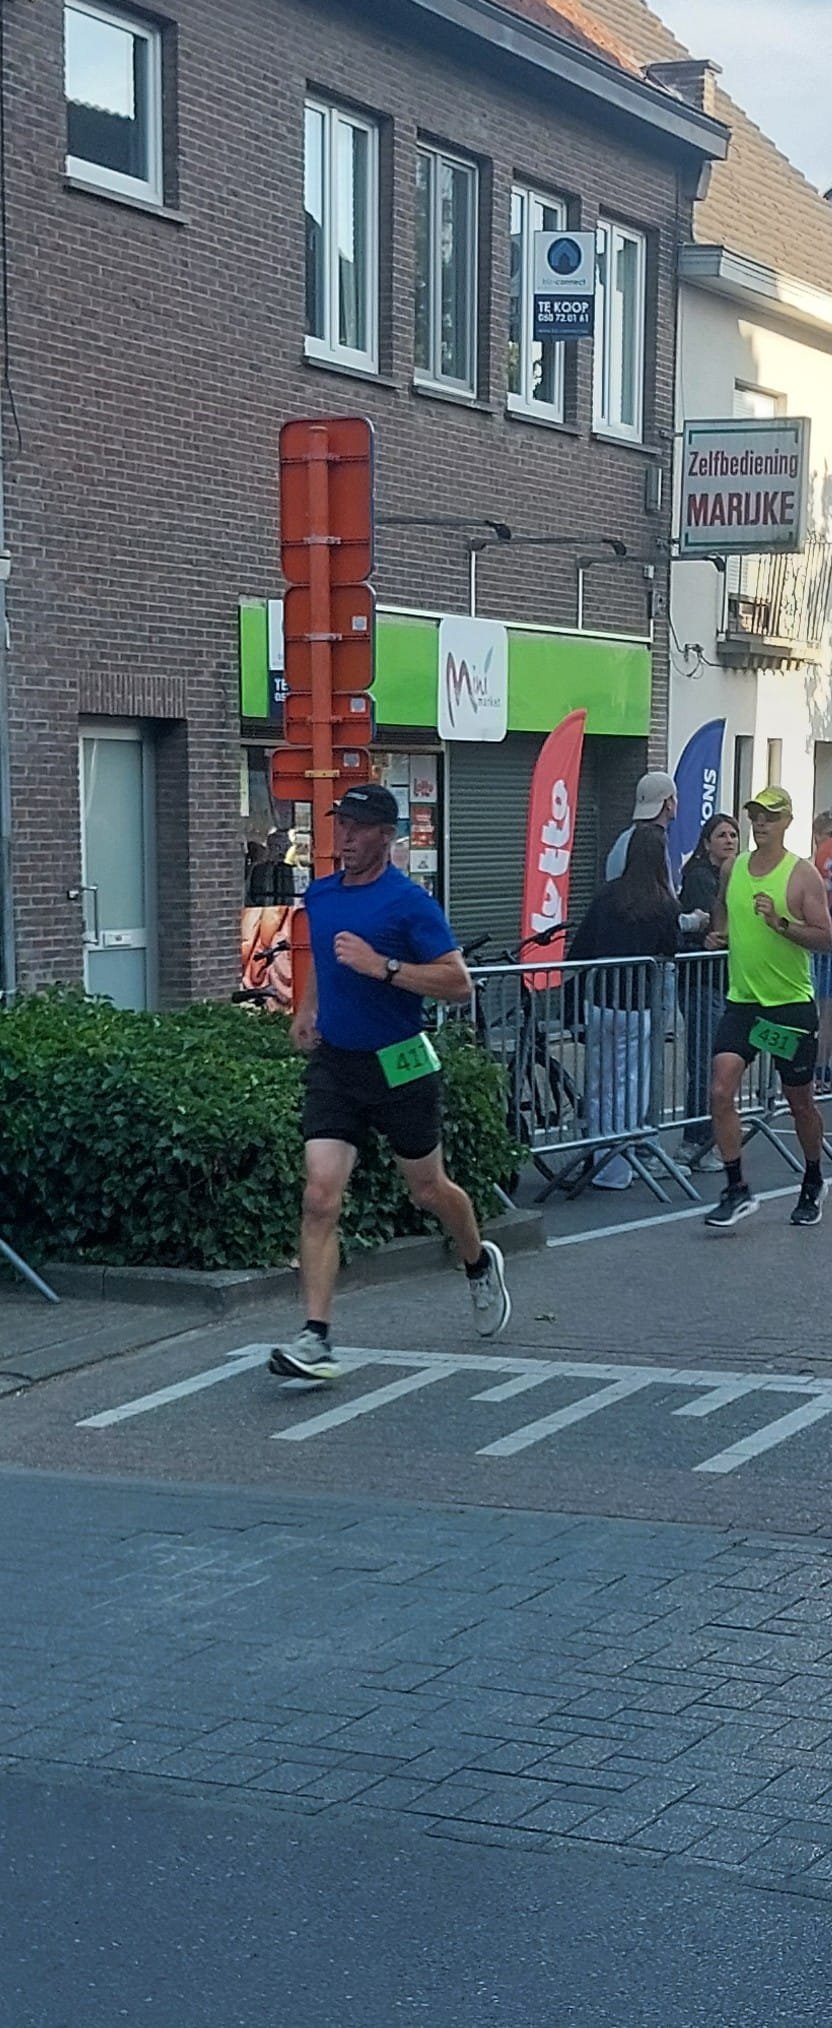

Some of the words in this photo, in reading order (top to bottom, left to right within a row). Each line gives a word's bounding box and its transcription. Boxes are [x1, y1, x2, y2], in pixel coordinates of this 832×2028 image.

[538, 301, 551, 313] TE
[554, 301, 589, 313] KOOP
[688, 448, 799, 478] Zelfbediening
[687, 491, 795, 527] MARIJKE
[274, 691, 287, 702] 05
[446, 646, 494, 728] Mini
[758, 1028, 789, 1050] 431
